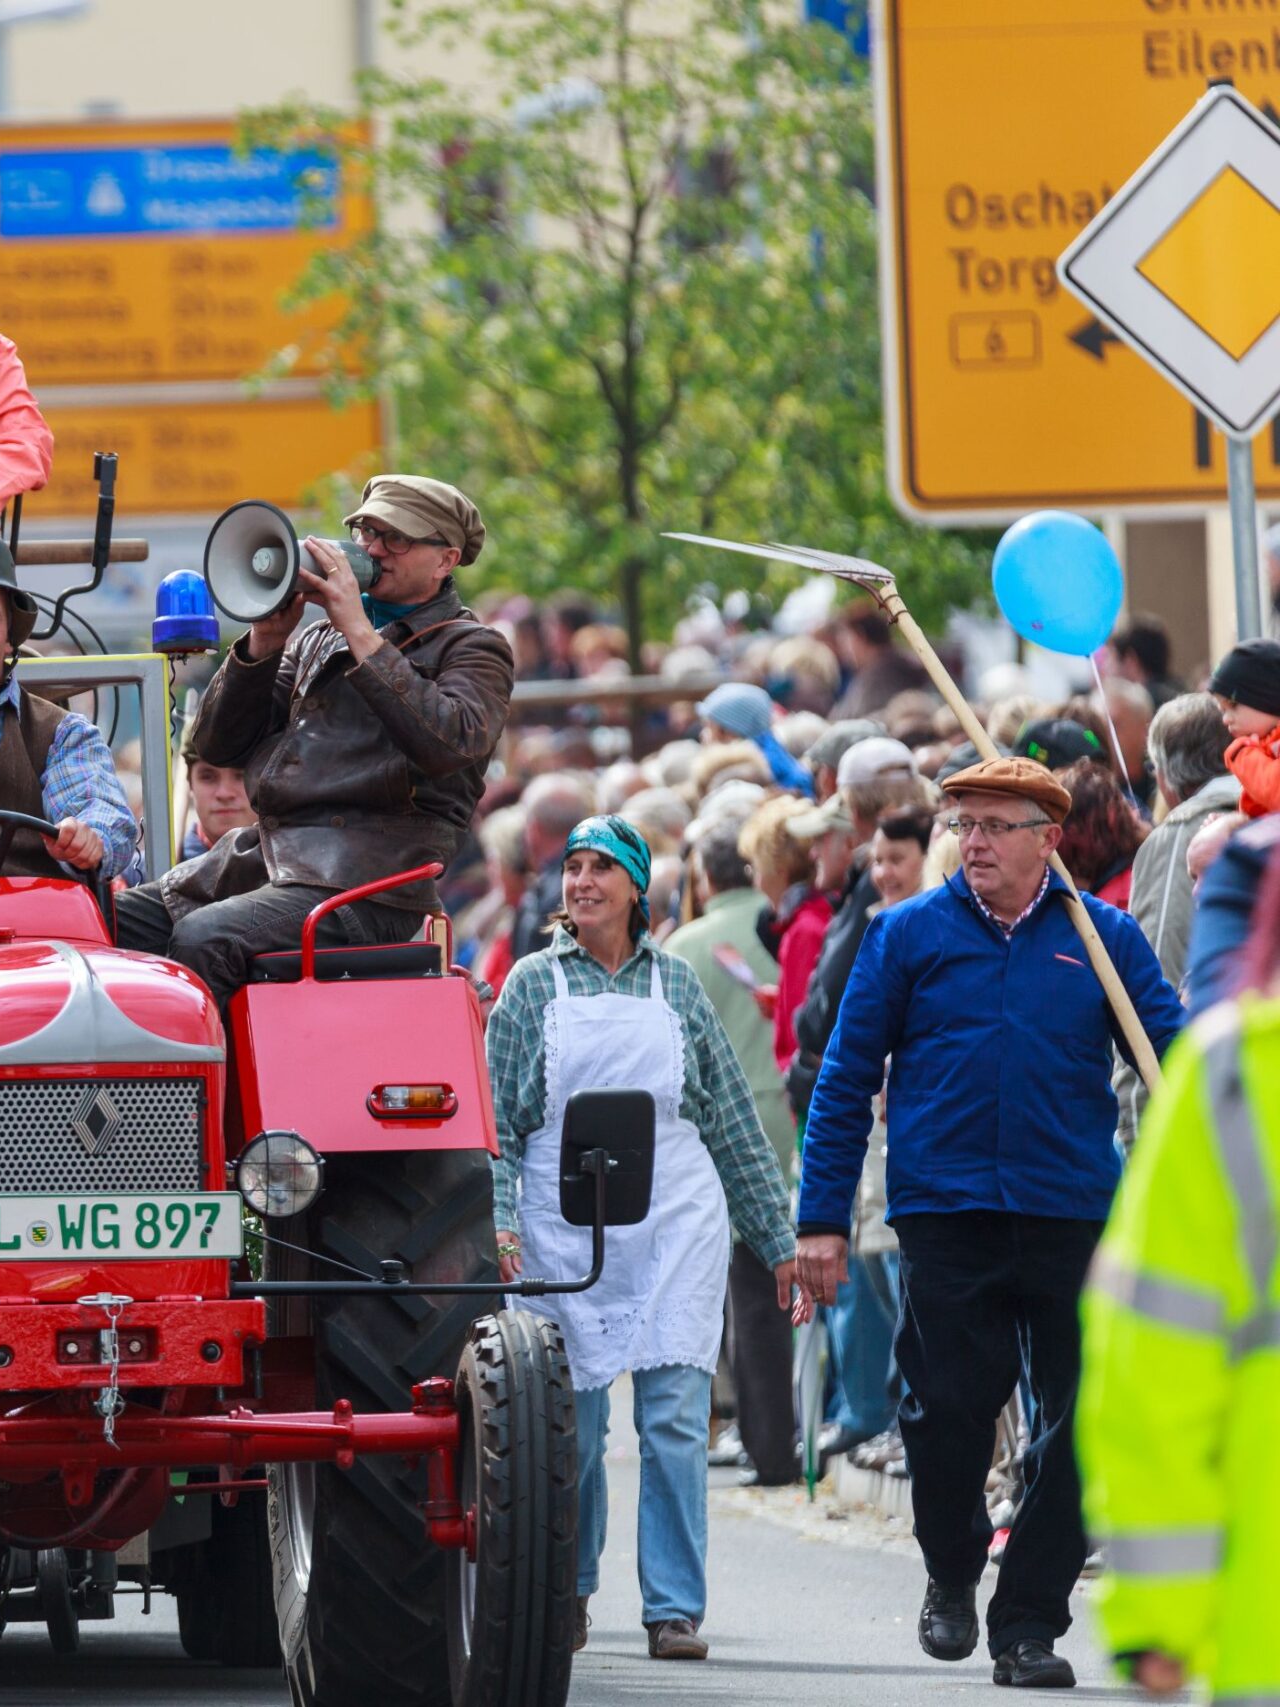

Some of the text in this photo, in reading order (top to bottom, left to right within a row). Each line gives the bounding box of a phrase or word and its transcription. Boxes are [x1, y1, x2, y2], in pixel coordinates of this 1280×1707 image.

[948, 247, 1059, 304] Torg
[57, 1203, 120, 1250] WG
[135, 1202, 220, 1250] 897
